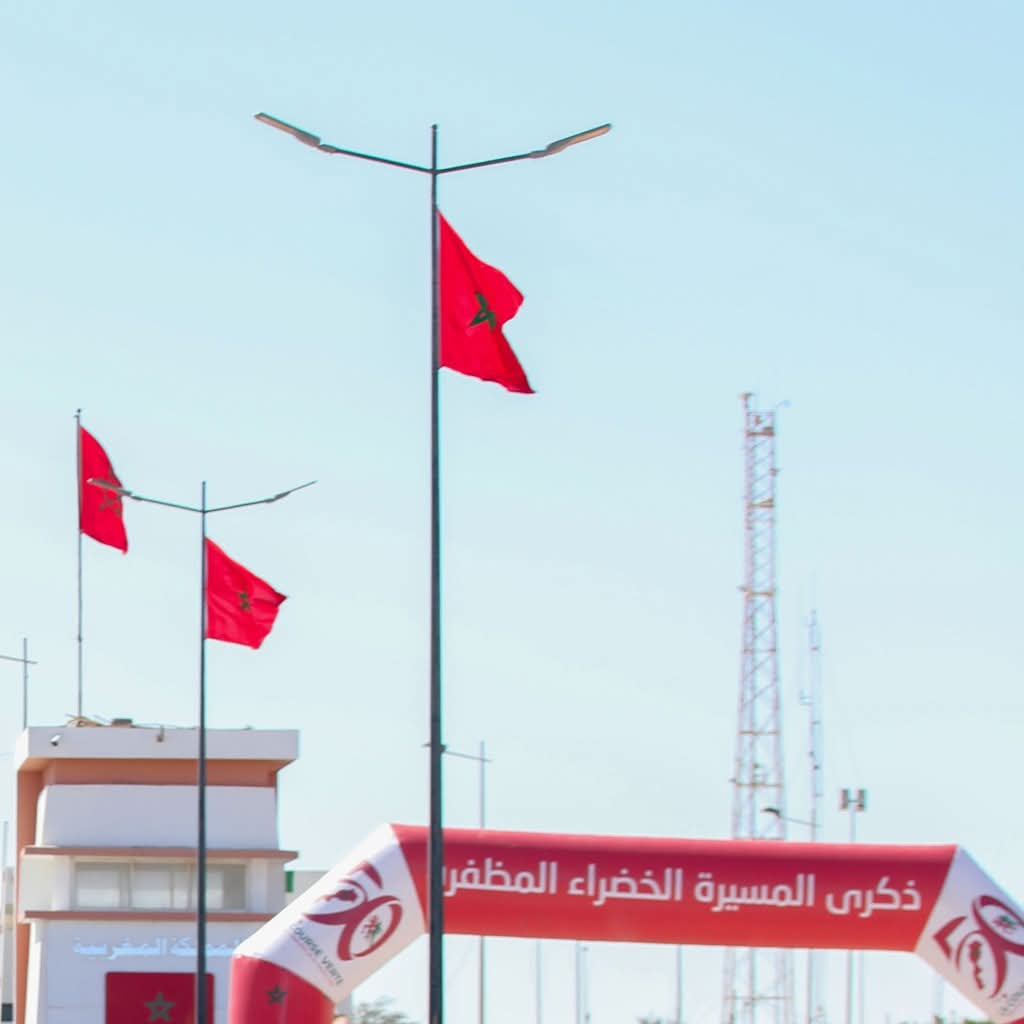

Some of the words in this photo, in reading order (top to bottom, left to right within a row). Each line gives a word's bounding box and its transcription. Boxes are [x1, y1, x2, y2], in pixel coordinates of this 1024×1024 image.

[442, 856, 558, 897] المظفر
[568, 863, 682, 907] الخضراء
[694, 871, 815, 911] المسيرة
[826, 876, 922, 918] ذكرى
